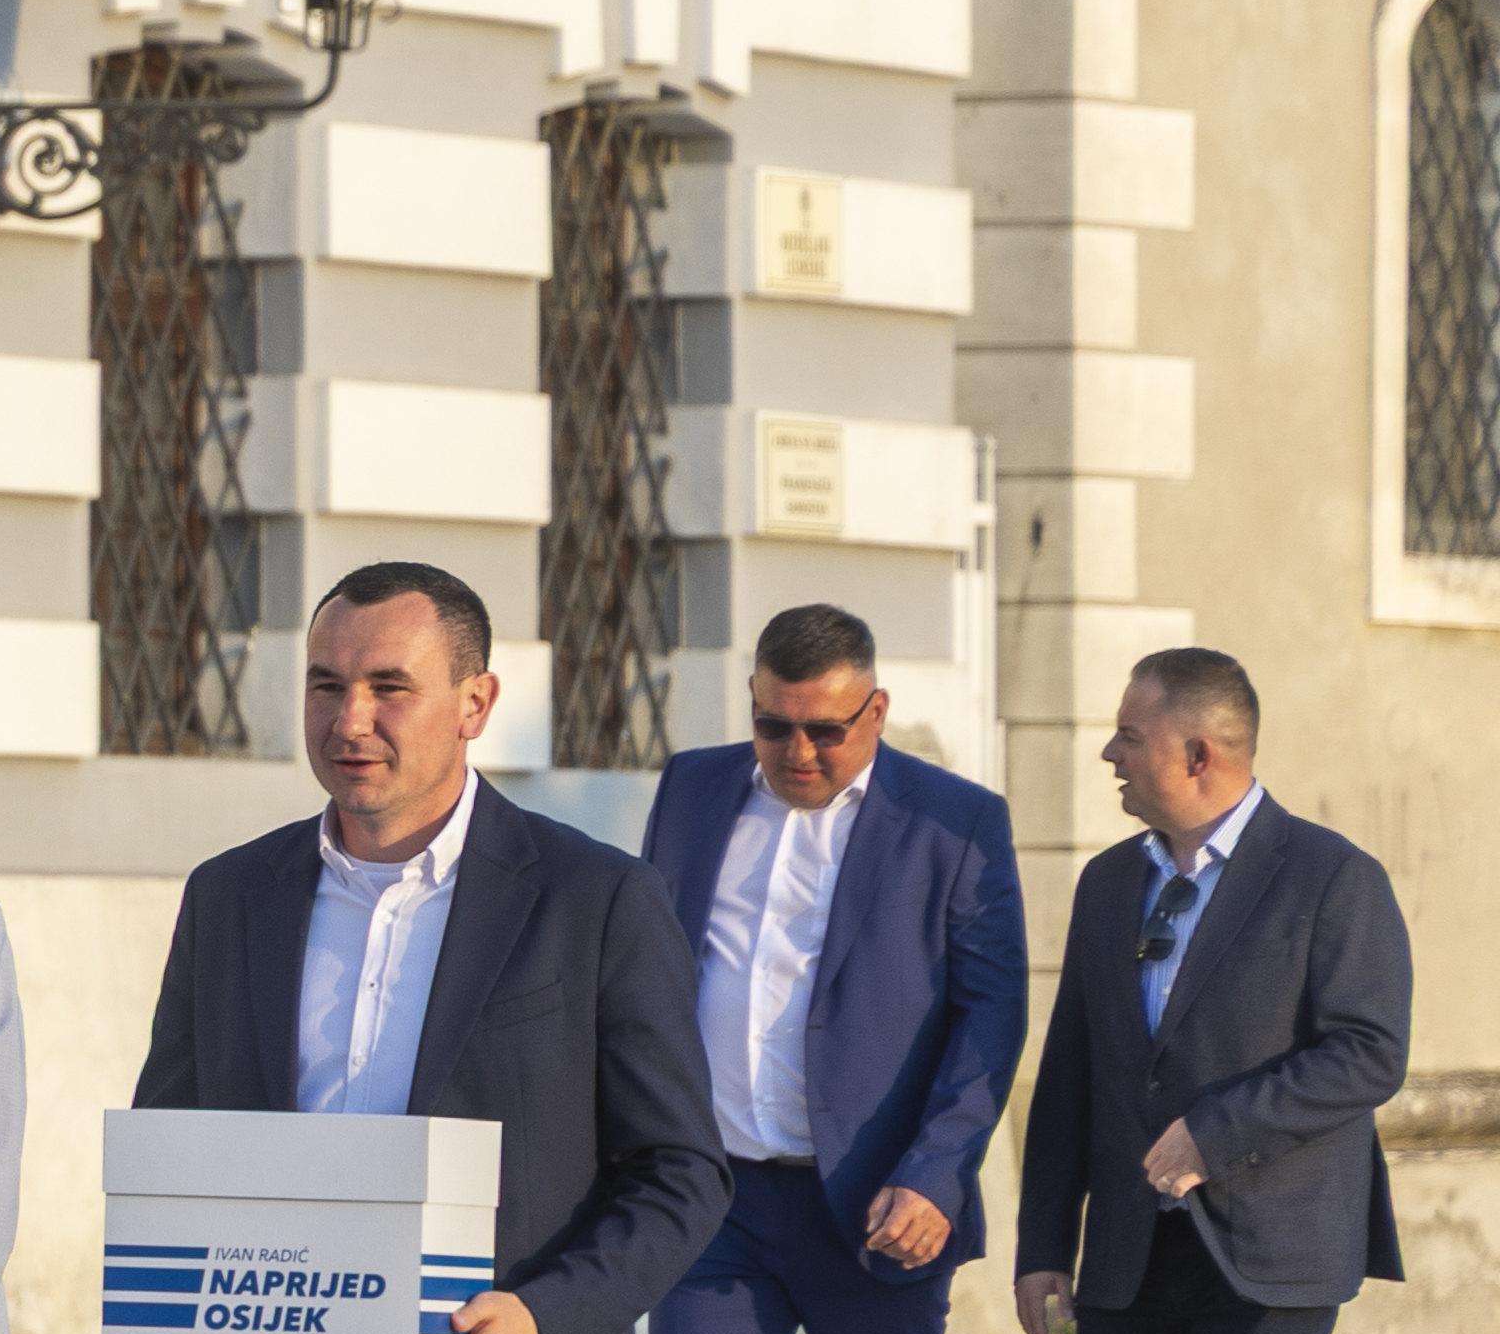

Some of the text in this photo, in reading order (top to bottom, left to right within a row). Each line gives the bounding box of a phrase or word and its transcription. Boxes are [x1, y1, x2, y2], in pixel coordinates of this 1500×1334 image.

[214, 1246, 310, 1263] IVAN RADIĆ
[209, 1268, 387, 1299] NAPRIJED
[203, 1303, 330, 1334] OSIJEK
